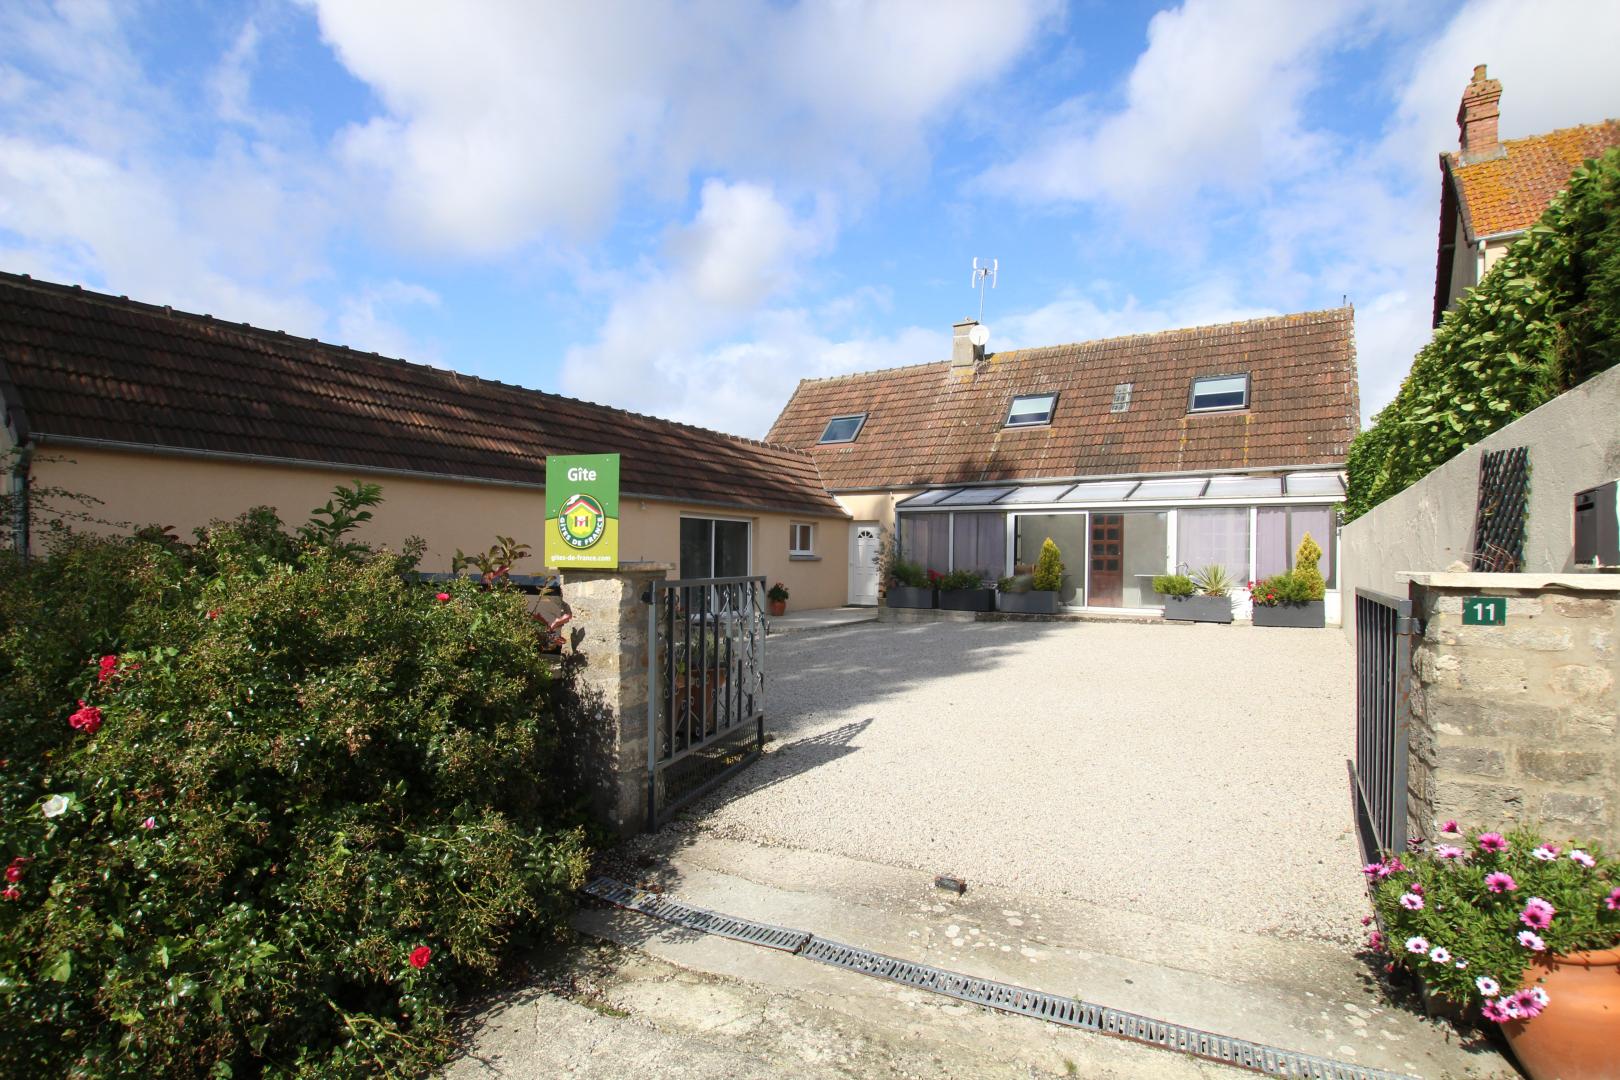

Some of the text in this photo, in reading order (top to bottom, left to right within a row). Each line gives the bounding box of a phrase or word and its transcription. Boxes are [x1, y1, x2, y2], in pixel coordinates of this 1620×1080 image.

[568, 467, 597, 481] Gîte
[585, 516, 603, 546] FRANCE
[1473, 603, 1495, 621] 11
